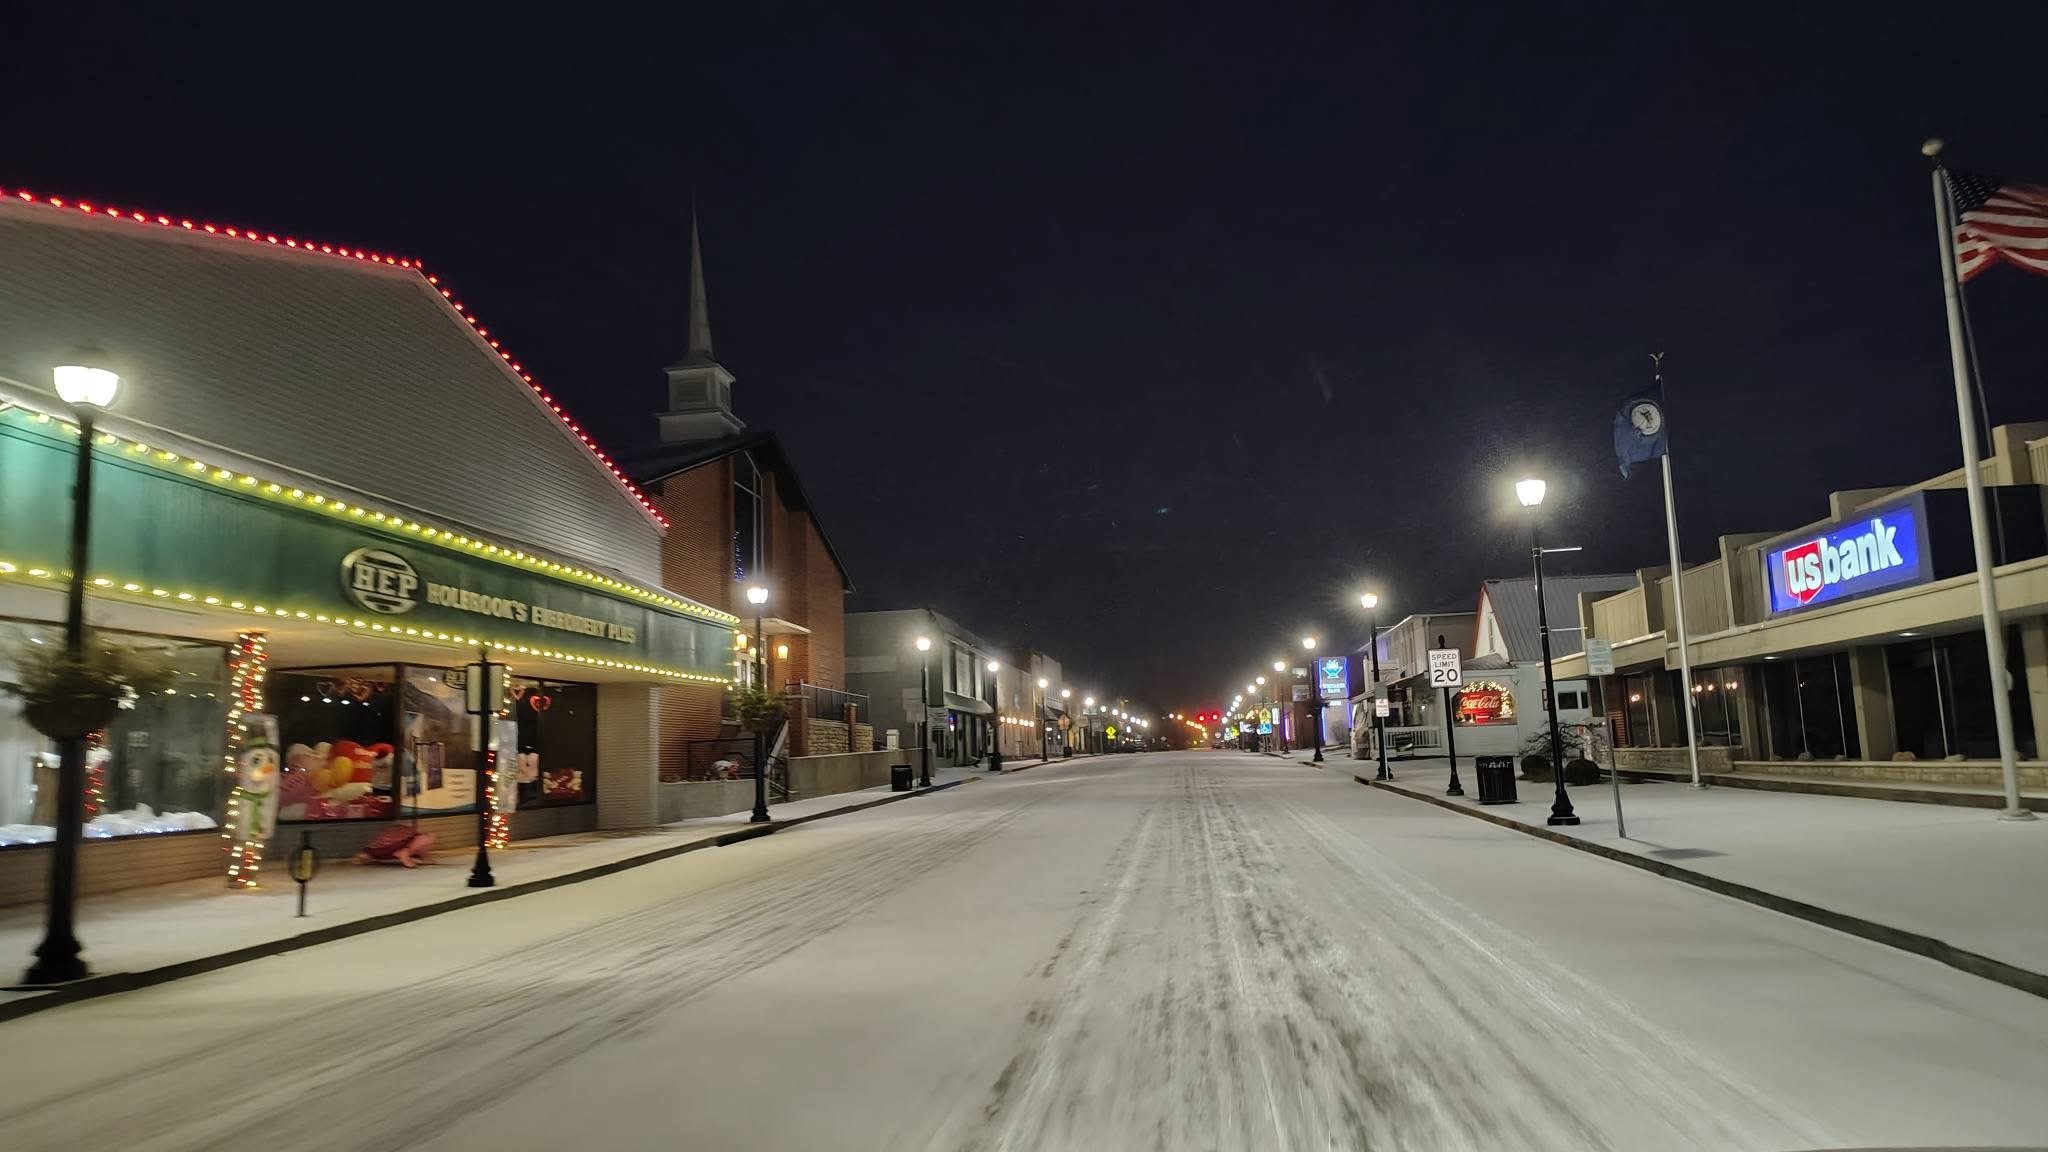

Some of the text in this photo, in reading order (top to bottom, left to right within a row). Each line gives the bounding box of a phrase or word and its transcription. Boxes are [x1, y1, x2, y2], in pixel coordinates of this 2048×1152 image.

[352, 562, 418, 599] HEP
[1431, 653, 1457, 661] SPEED
[1433, 669, 1458, 683] 20
